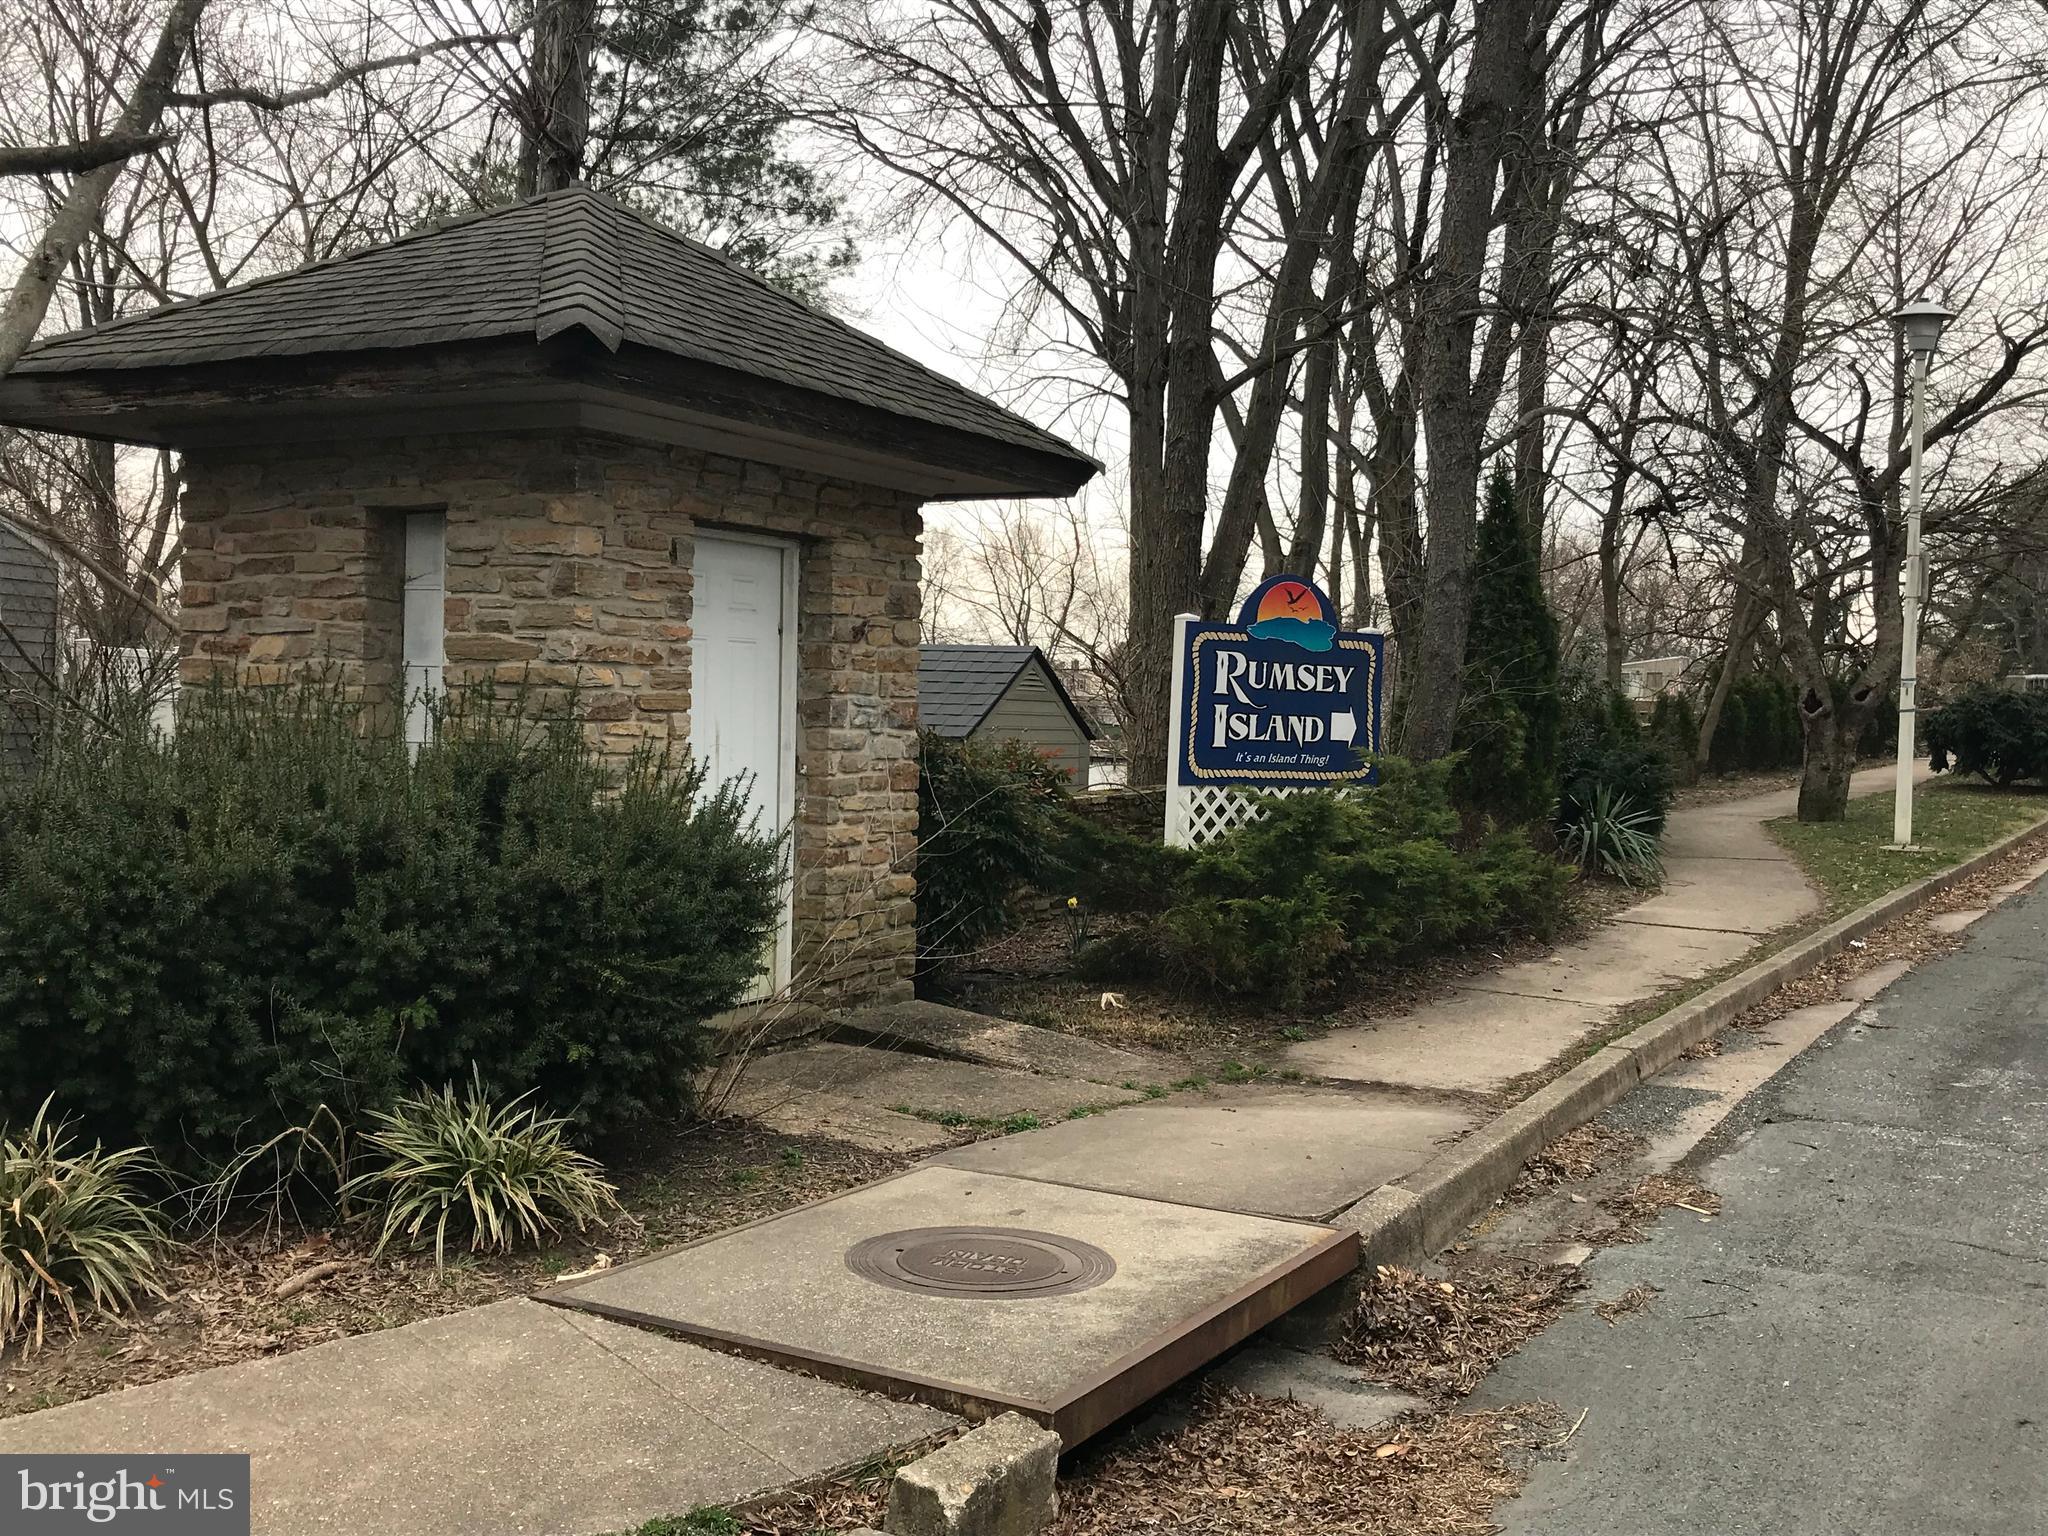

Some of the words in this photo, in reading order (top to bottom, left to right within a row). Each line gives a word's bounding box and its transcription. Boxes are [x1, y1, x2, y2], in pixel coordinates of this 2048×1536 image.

[1213, 650, 1355, 709] RUMSEY
[1212, 704, 1325, 748] ISLAND
[1235, 751, 1252, 763] It's
[1253, 754, 1266, 763] an
[1267, 752, 1298, 764] Island
[1299, 754, 1330, 767] Thing!
[929, 1256, 1024, 1276] STORM
[944, 1249, 1029, 1266] DRAIN
